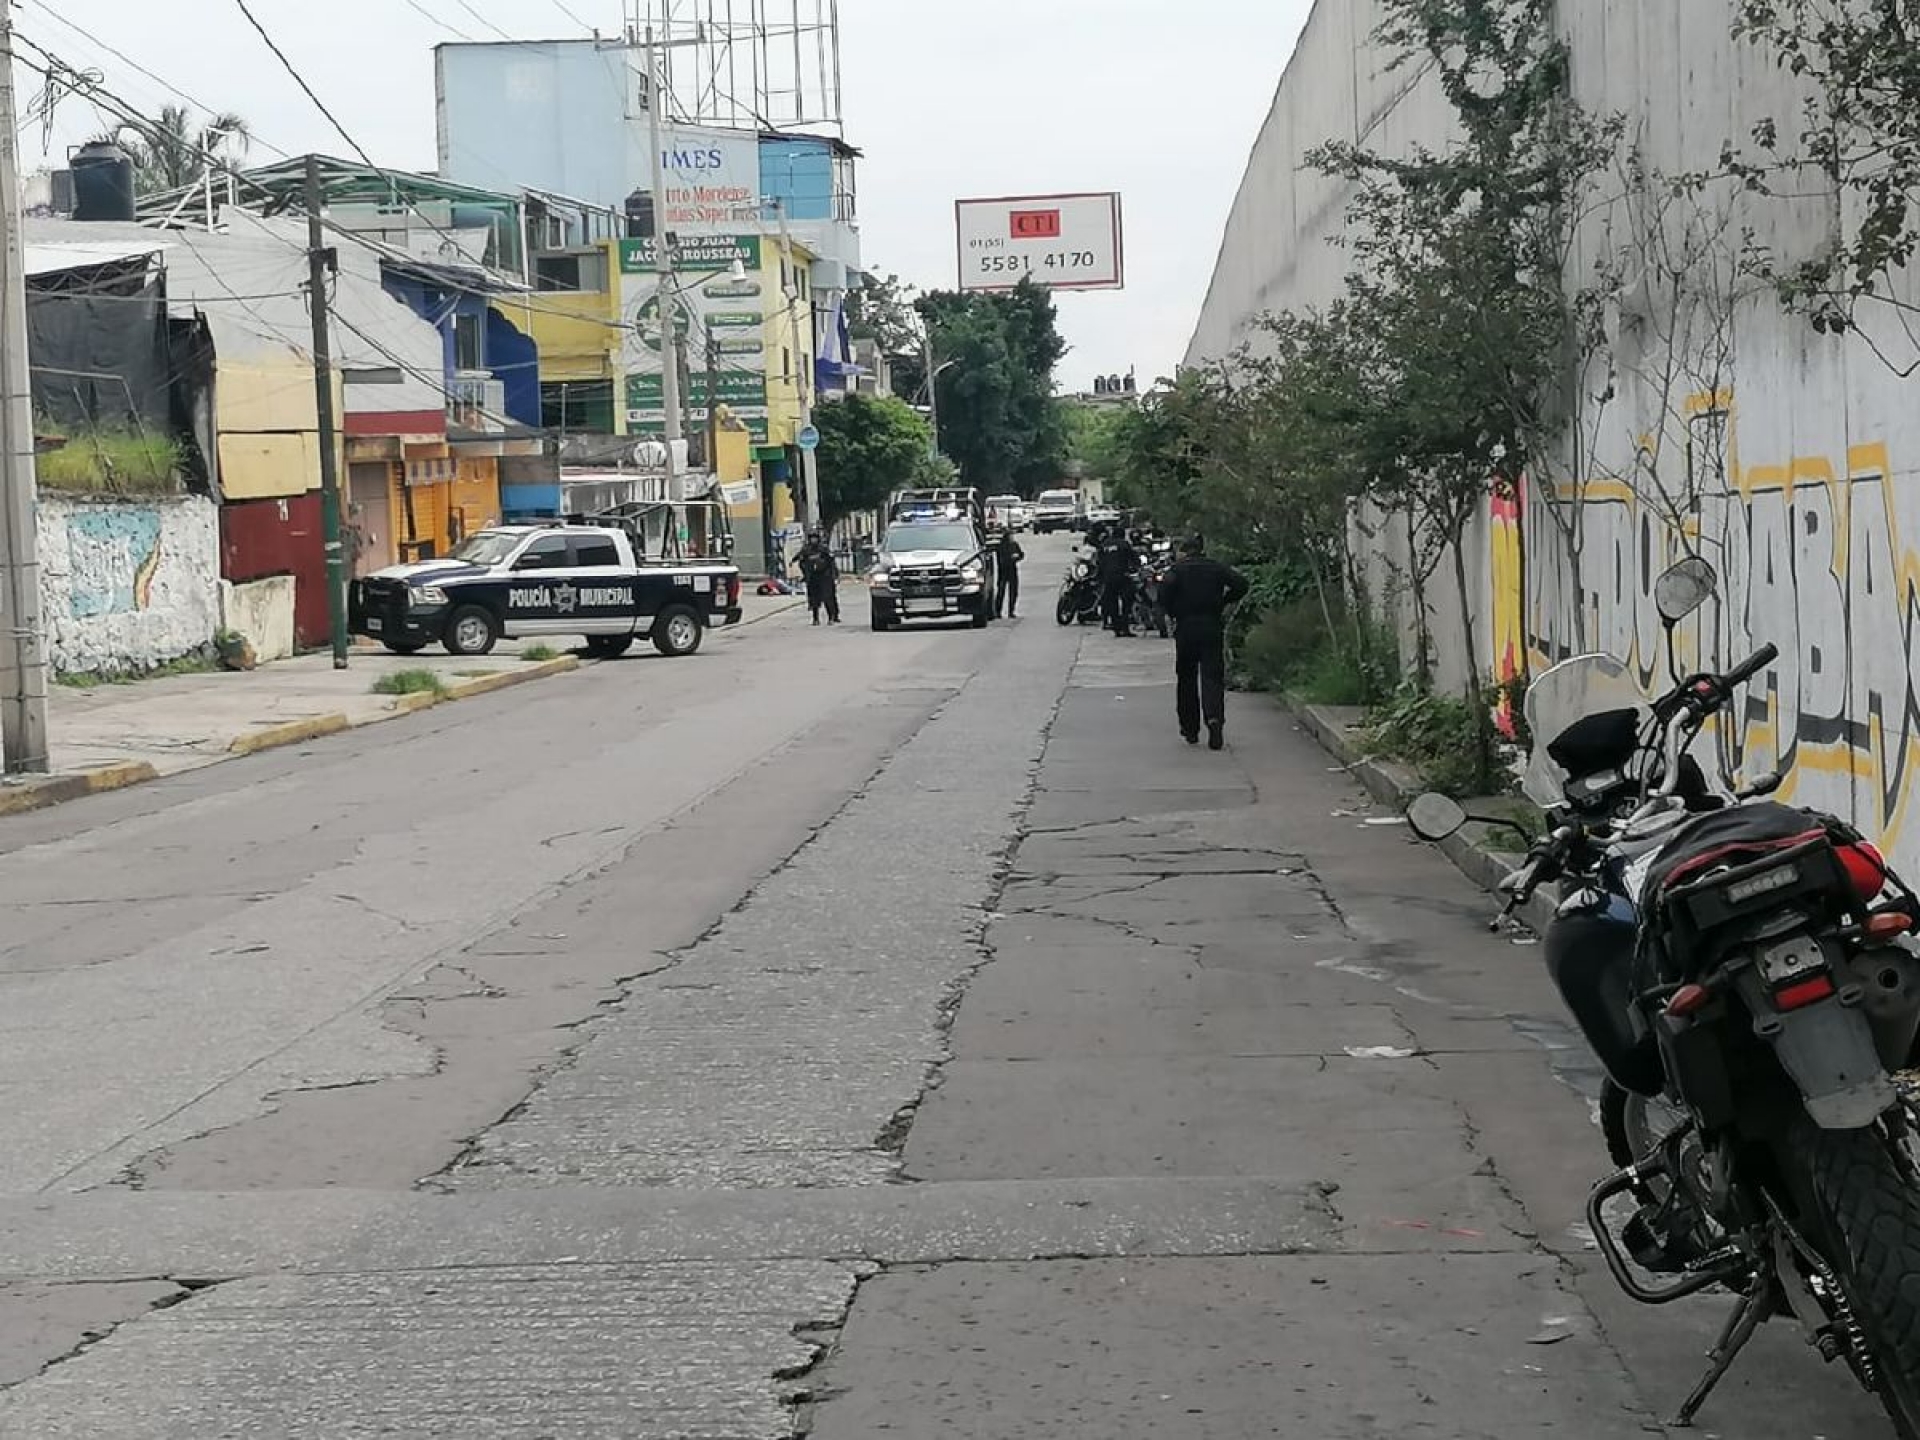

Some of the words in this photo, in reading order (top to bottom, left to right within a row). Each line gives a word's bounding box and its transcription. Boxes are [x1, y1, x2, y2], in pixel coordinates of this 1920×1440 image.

[1017, 215, 1054, 232] CTI
[701, 236, 737, 247] JUAN
[682, 247, 751, 260] ROUSSEAU
[981, 255, 1029, 272] 5581
[1045, 251, 1094, 268] 4170
